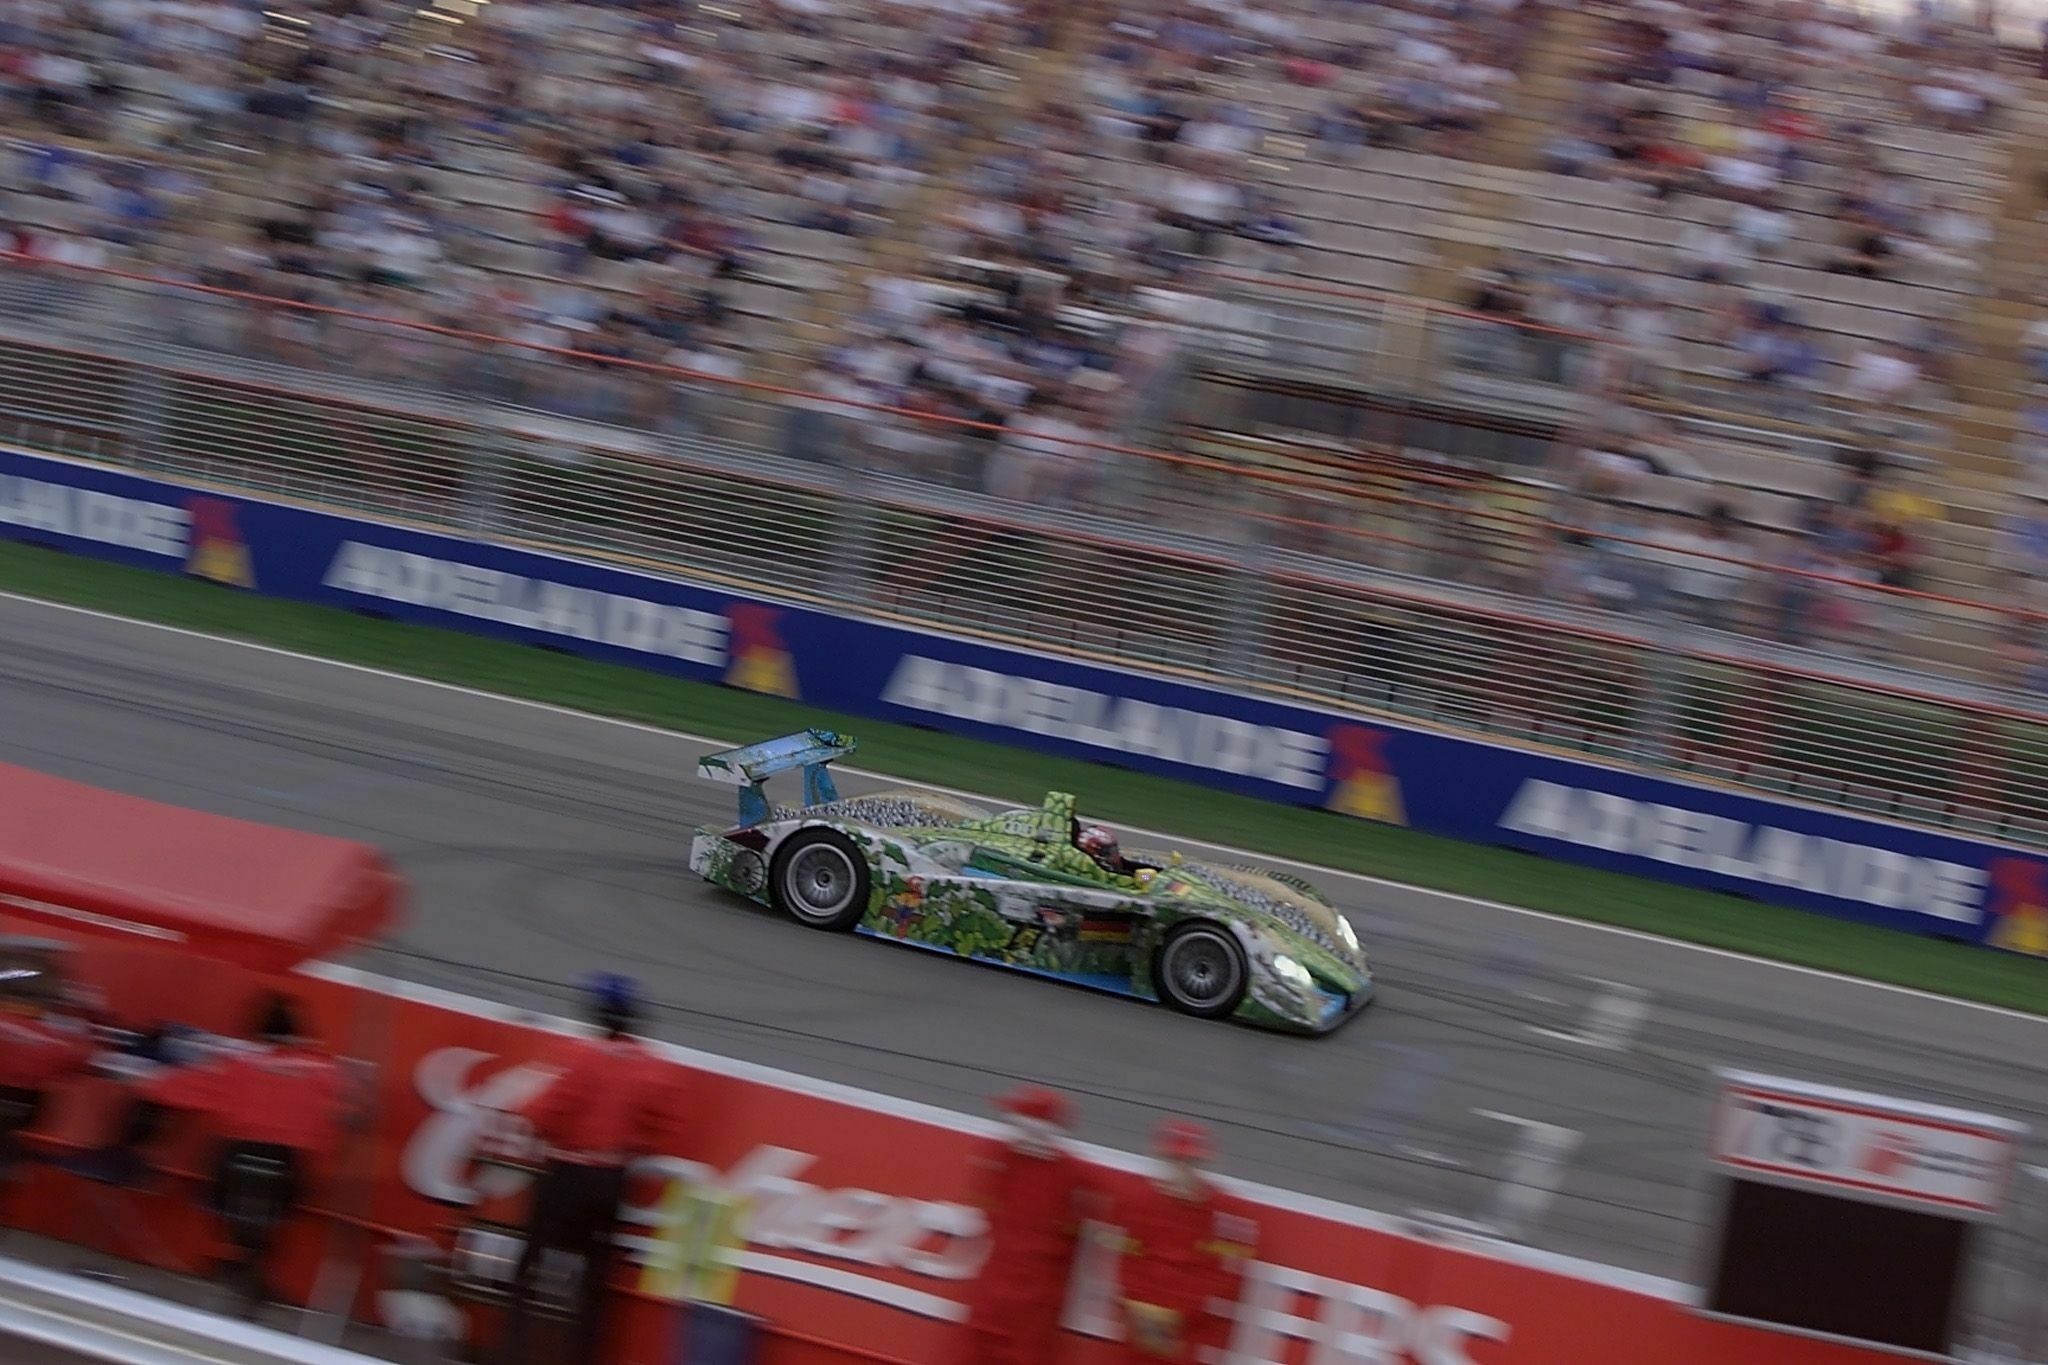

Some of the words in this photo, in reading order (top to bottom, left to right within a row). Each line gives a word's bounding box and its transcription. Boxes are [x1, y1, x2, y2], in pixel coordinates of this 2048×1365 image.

[323, 540, 730, 667] ADELAIDE
[881, 654, 1332, 793] ADELAIDE
[1497, 777, 1988, 925] ADELAIDE
